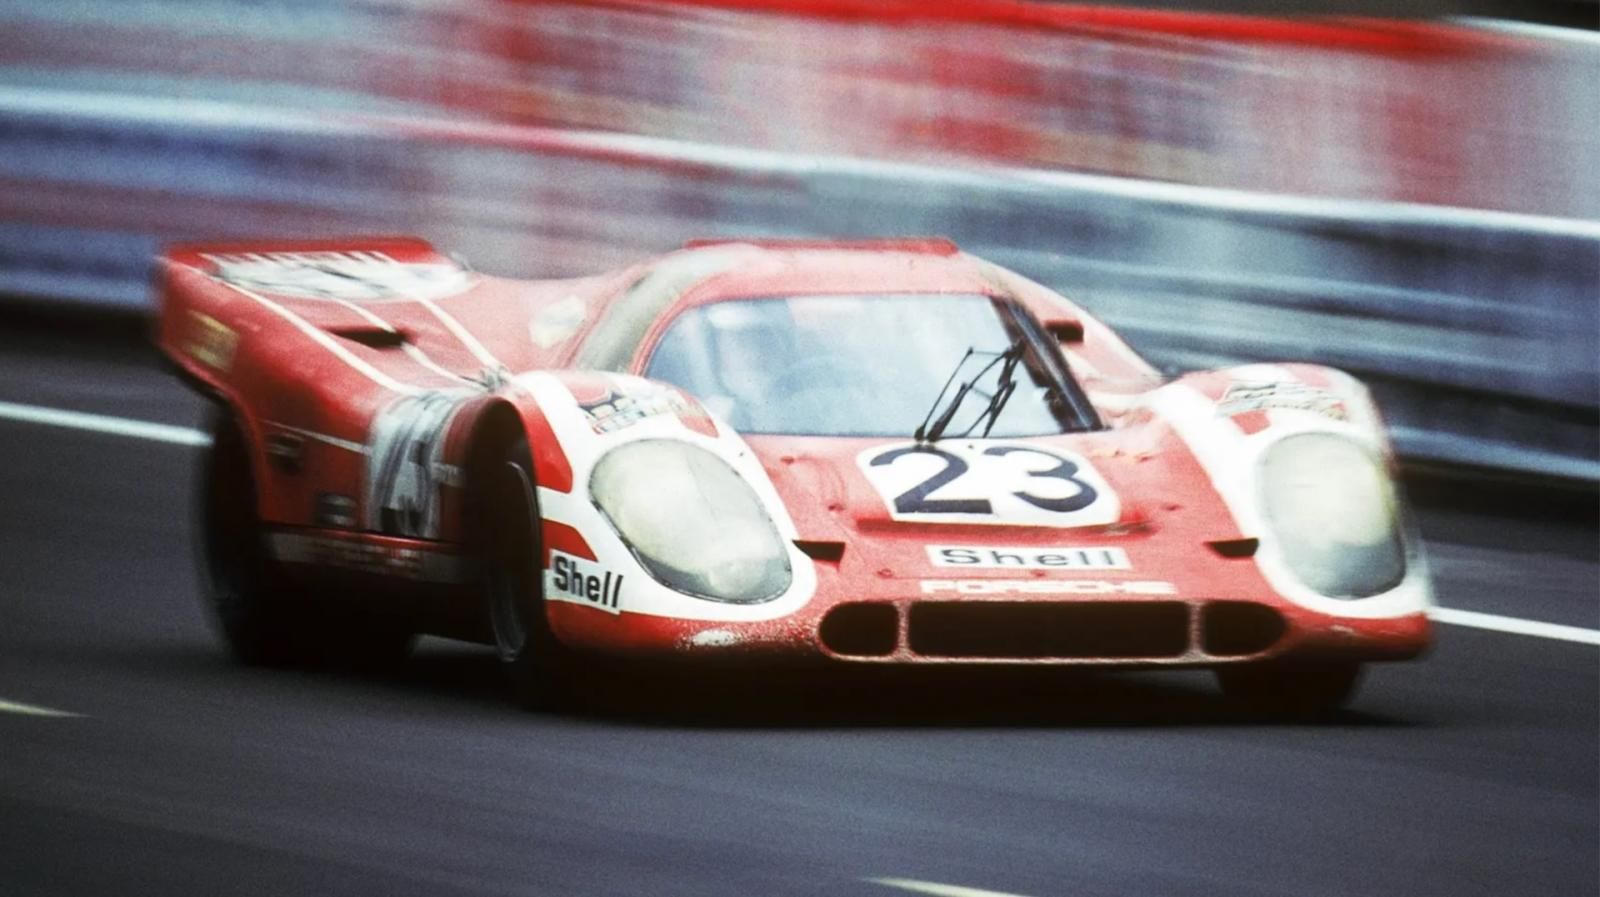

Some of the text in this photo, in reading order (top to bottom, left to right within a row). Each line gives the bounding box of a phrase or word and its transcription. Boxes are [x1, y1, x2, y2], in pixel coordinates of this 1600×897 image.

[869, 445, 1098, 514] 23
[553, 555, 624, 608] Shell
[941, 548, 1116, 566] Shell
